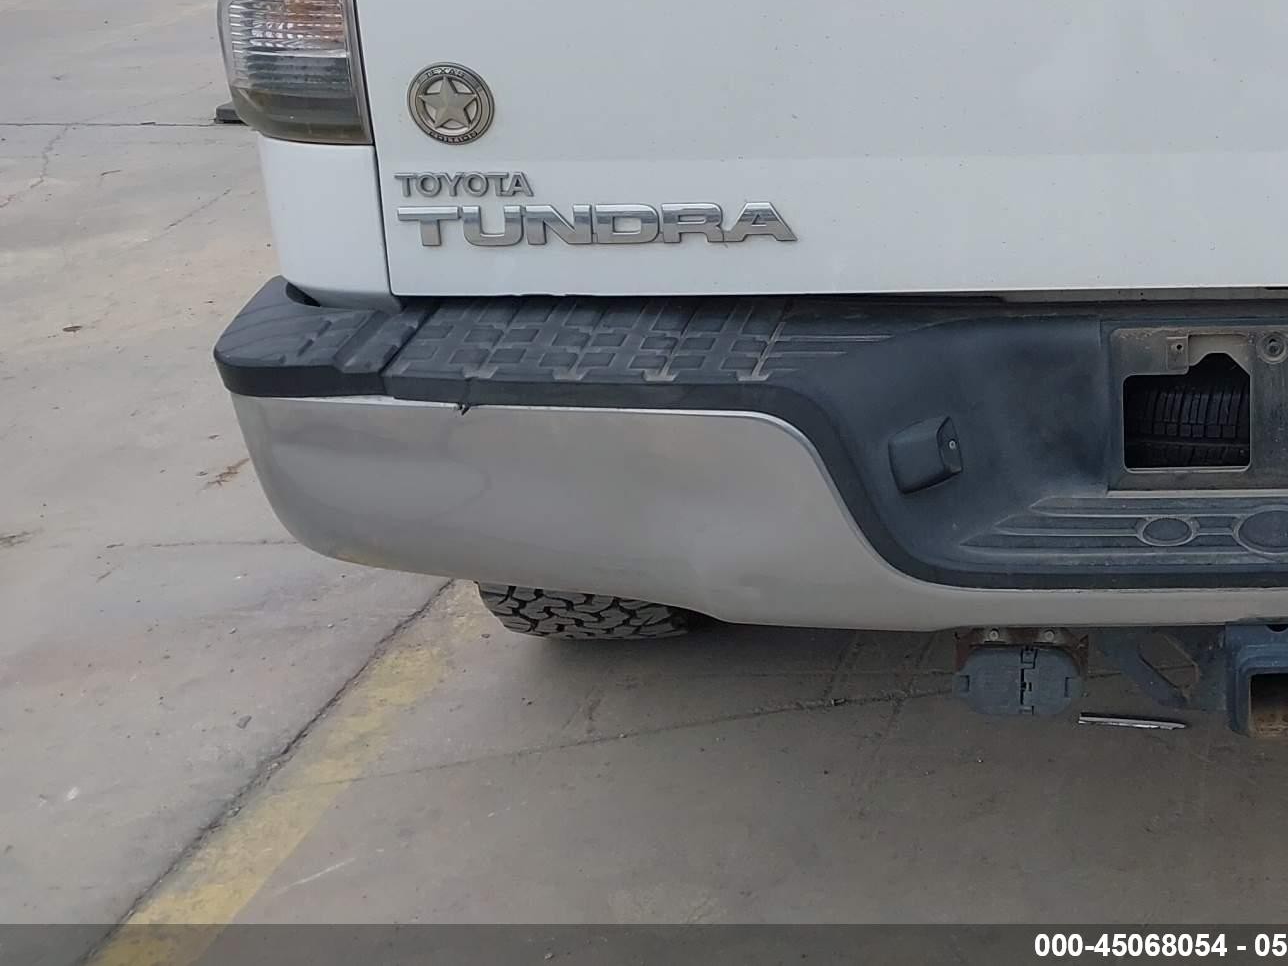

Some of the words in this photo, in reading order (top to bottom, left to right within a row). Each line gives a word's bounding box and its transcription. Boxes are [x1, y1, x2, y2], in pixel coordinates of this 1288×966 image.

[426, 67, 466, 78] TEXAS
[428, 130, 478, 143] EDITION
[394, 171, 534, 197] TOYOTA
[397, 201, 798, 246] TUNDRA
